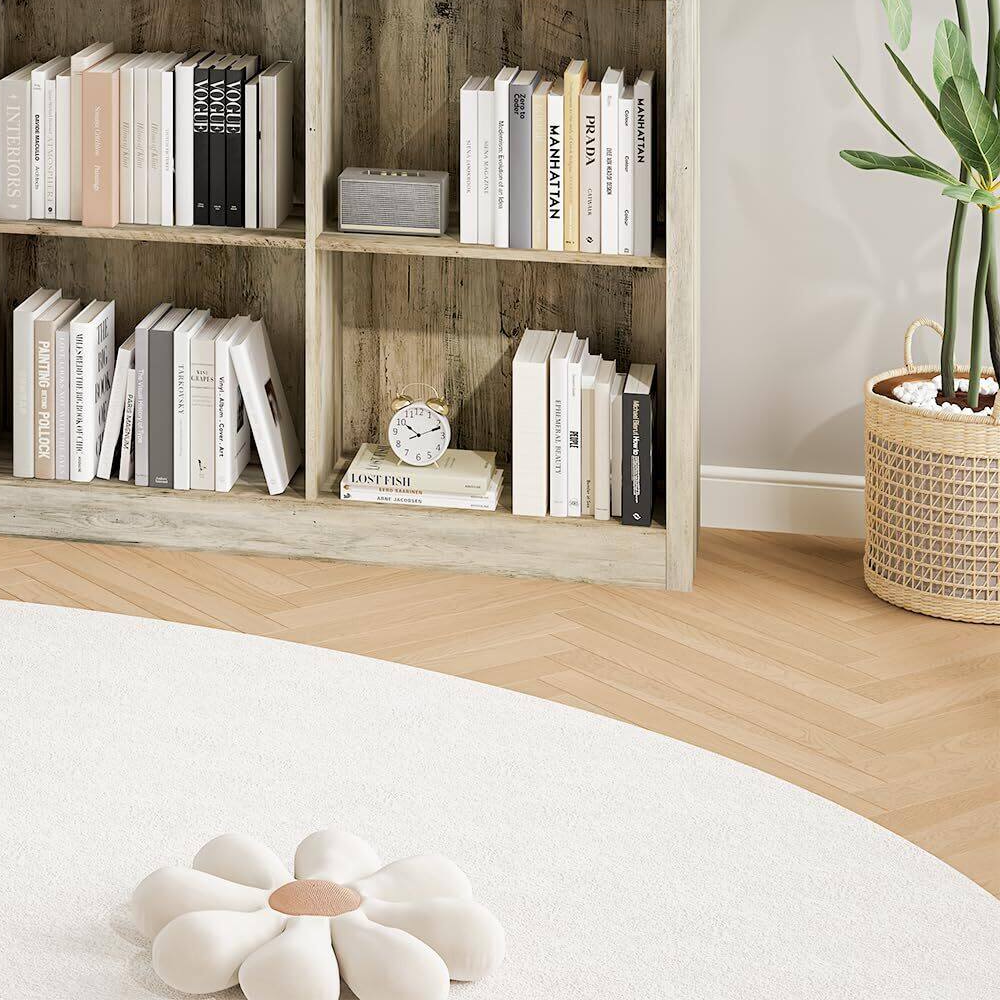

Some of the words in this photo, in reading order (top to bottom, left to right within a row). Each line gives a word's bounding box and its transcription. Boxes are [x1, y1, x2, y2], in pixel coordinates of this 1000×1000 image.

[193, 79, 209, 134] VOGUE
[209, 79, 225, 134] VOGUE
[225, 79, 241, 134] VOGUE
[519, 111, 526, 120] to
[637, 98, 645, 164] MANHATTAN
[585, 115, 596, 166] PRADA
[6, 104, 21, 205] INTERIORS
[549, 125, 561, 220] MANHATTAN
[38, 341, 50, 388] PAINTING
[137, 369, 145, 381] The
[190, 375, 215, 383] GRAPES
[137, 381, 145, 400] Visual
[137, 400, 145, 422] History
[405, 410, 414, 418] 11
[415, 408, 424, 416] 12
[427, 411, 431, 419] 1
[632, 400, 640, 419] Michael
[397, 418, 407, 426] 10
[38, 411, 50, 459] POLLOCK
[122, 415, 132, 450] MAGNUM
[137, 430, 145, 444] Type
[569, 431, 579, 449] PEOPLE
[396, 440, 401, 448] 8
[632, 435, 640, 449] How
[416, 453, 421, 461] 6
[351, 473, 381, 486] LOST
[384, 475, 411, 487] FISH
